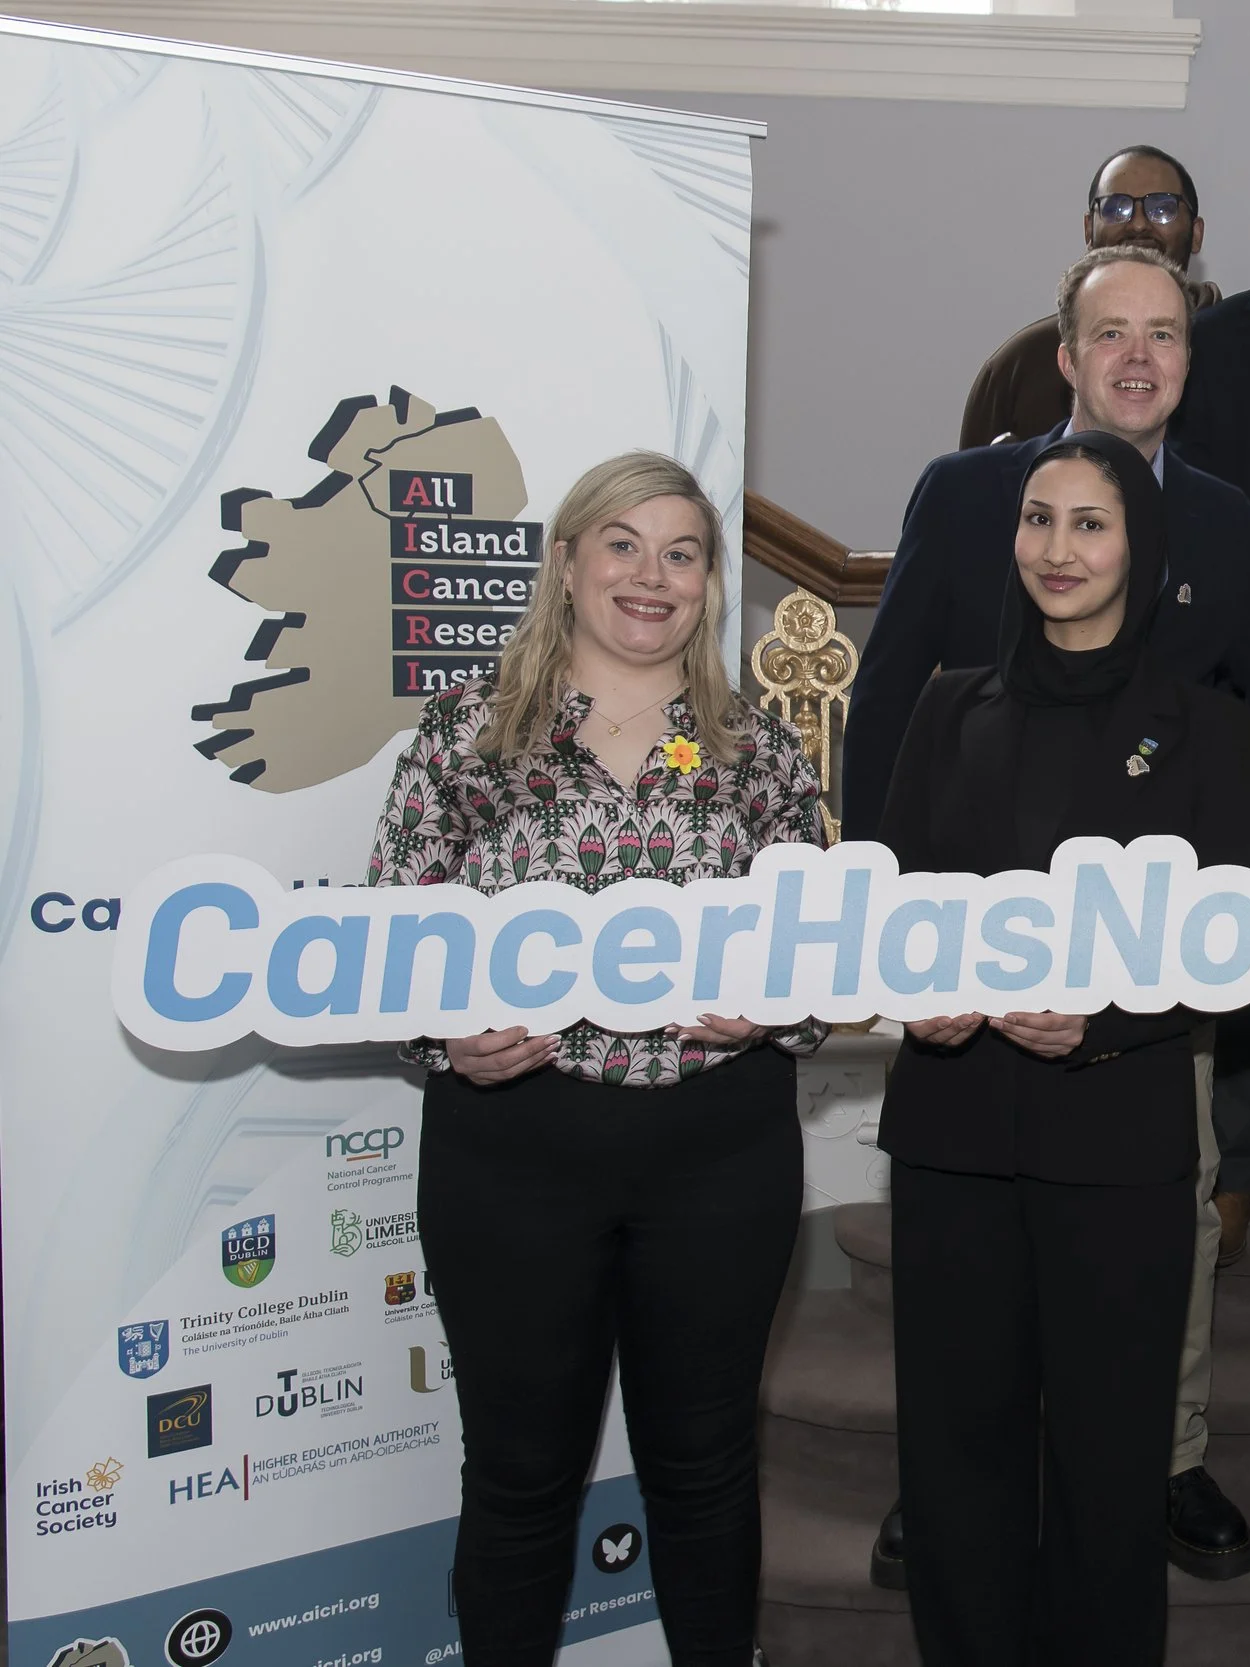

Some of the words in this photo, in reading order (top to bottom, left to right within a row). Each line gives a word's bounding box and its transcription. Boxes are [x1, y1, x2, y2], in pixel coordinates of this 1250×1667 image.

[402, 476, 457, 508] All
[404, 523, 528, 556] Island
[406, 616, 518, 646] Resea
[326, 1126, 405, 1160] nccp
[327, 1166, 365, 1180] National
[366, 1163, 397, 1174] Cancer
[327, 1180, 360, 1192] Control
[362, 1172, 414, 1187] Programme
[366, 1221, 416, 1240] LIMER
[366, 1237, 404, 1249] OLLSCOIL
[228, 1235, 270, 1254] UCD
[230, 1249, 268, 1261] DUBLIN
[180, 1311, 233, 1330] Trinity
[238, 1299, 294, 1319] College
[297, 1289, 349, 1308] Dublin
[384, 1305, 419, 1316] University
[181, 1329, 218, 1343] Coláiste
[279, 1314, 301, 1325] Baile
[303, 1309, 323, 1320] Átha
[324, 1305, 350, 1316] Cliath
[183, 1346, 200, 1356] The
[202, 1337, 247, 1353] University
[248, 1334, 258, 1344] of
[259, 1329, 289, 1342] Dublin
[159, 1412, 200, 1433] DCU
[252, 1474, 269, 1486] AN
[329, 1457, 348, 1468] um
[350, 1434, 440, 1463] ARD-OIDEACHAS
[253, 1453, 298, 1473] HIGHER
[302, 1437, 370, 1462] EDUCATION
[373, 1421, 440, 1446] AUTHORITY
[36, 1477, 82, 1498] Irish
[169, 1467, 240, 1504] HEA
[36, 1493, 114, 1517] Cancer
[36, 1511, 117, 1536] Society
[248, 1592, 380, 1637] www.aicri.org
